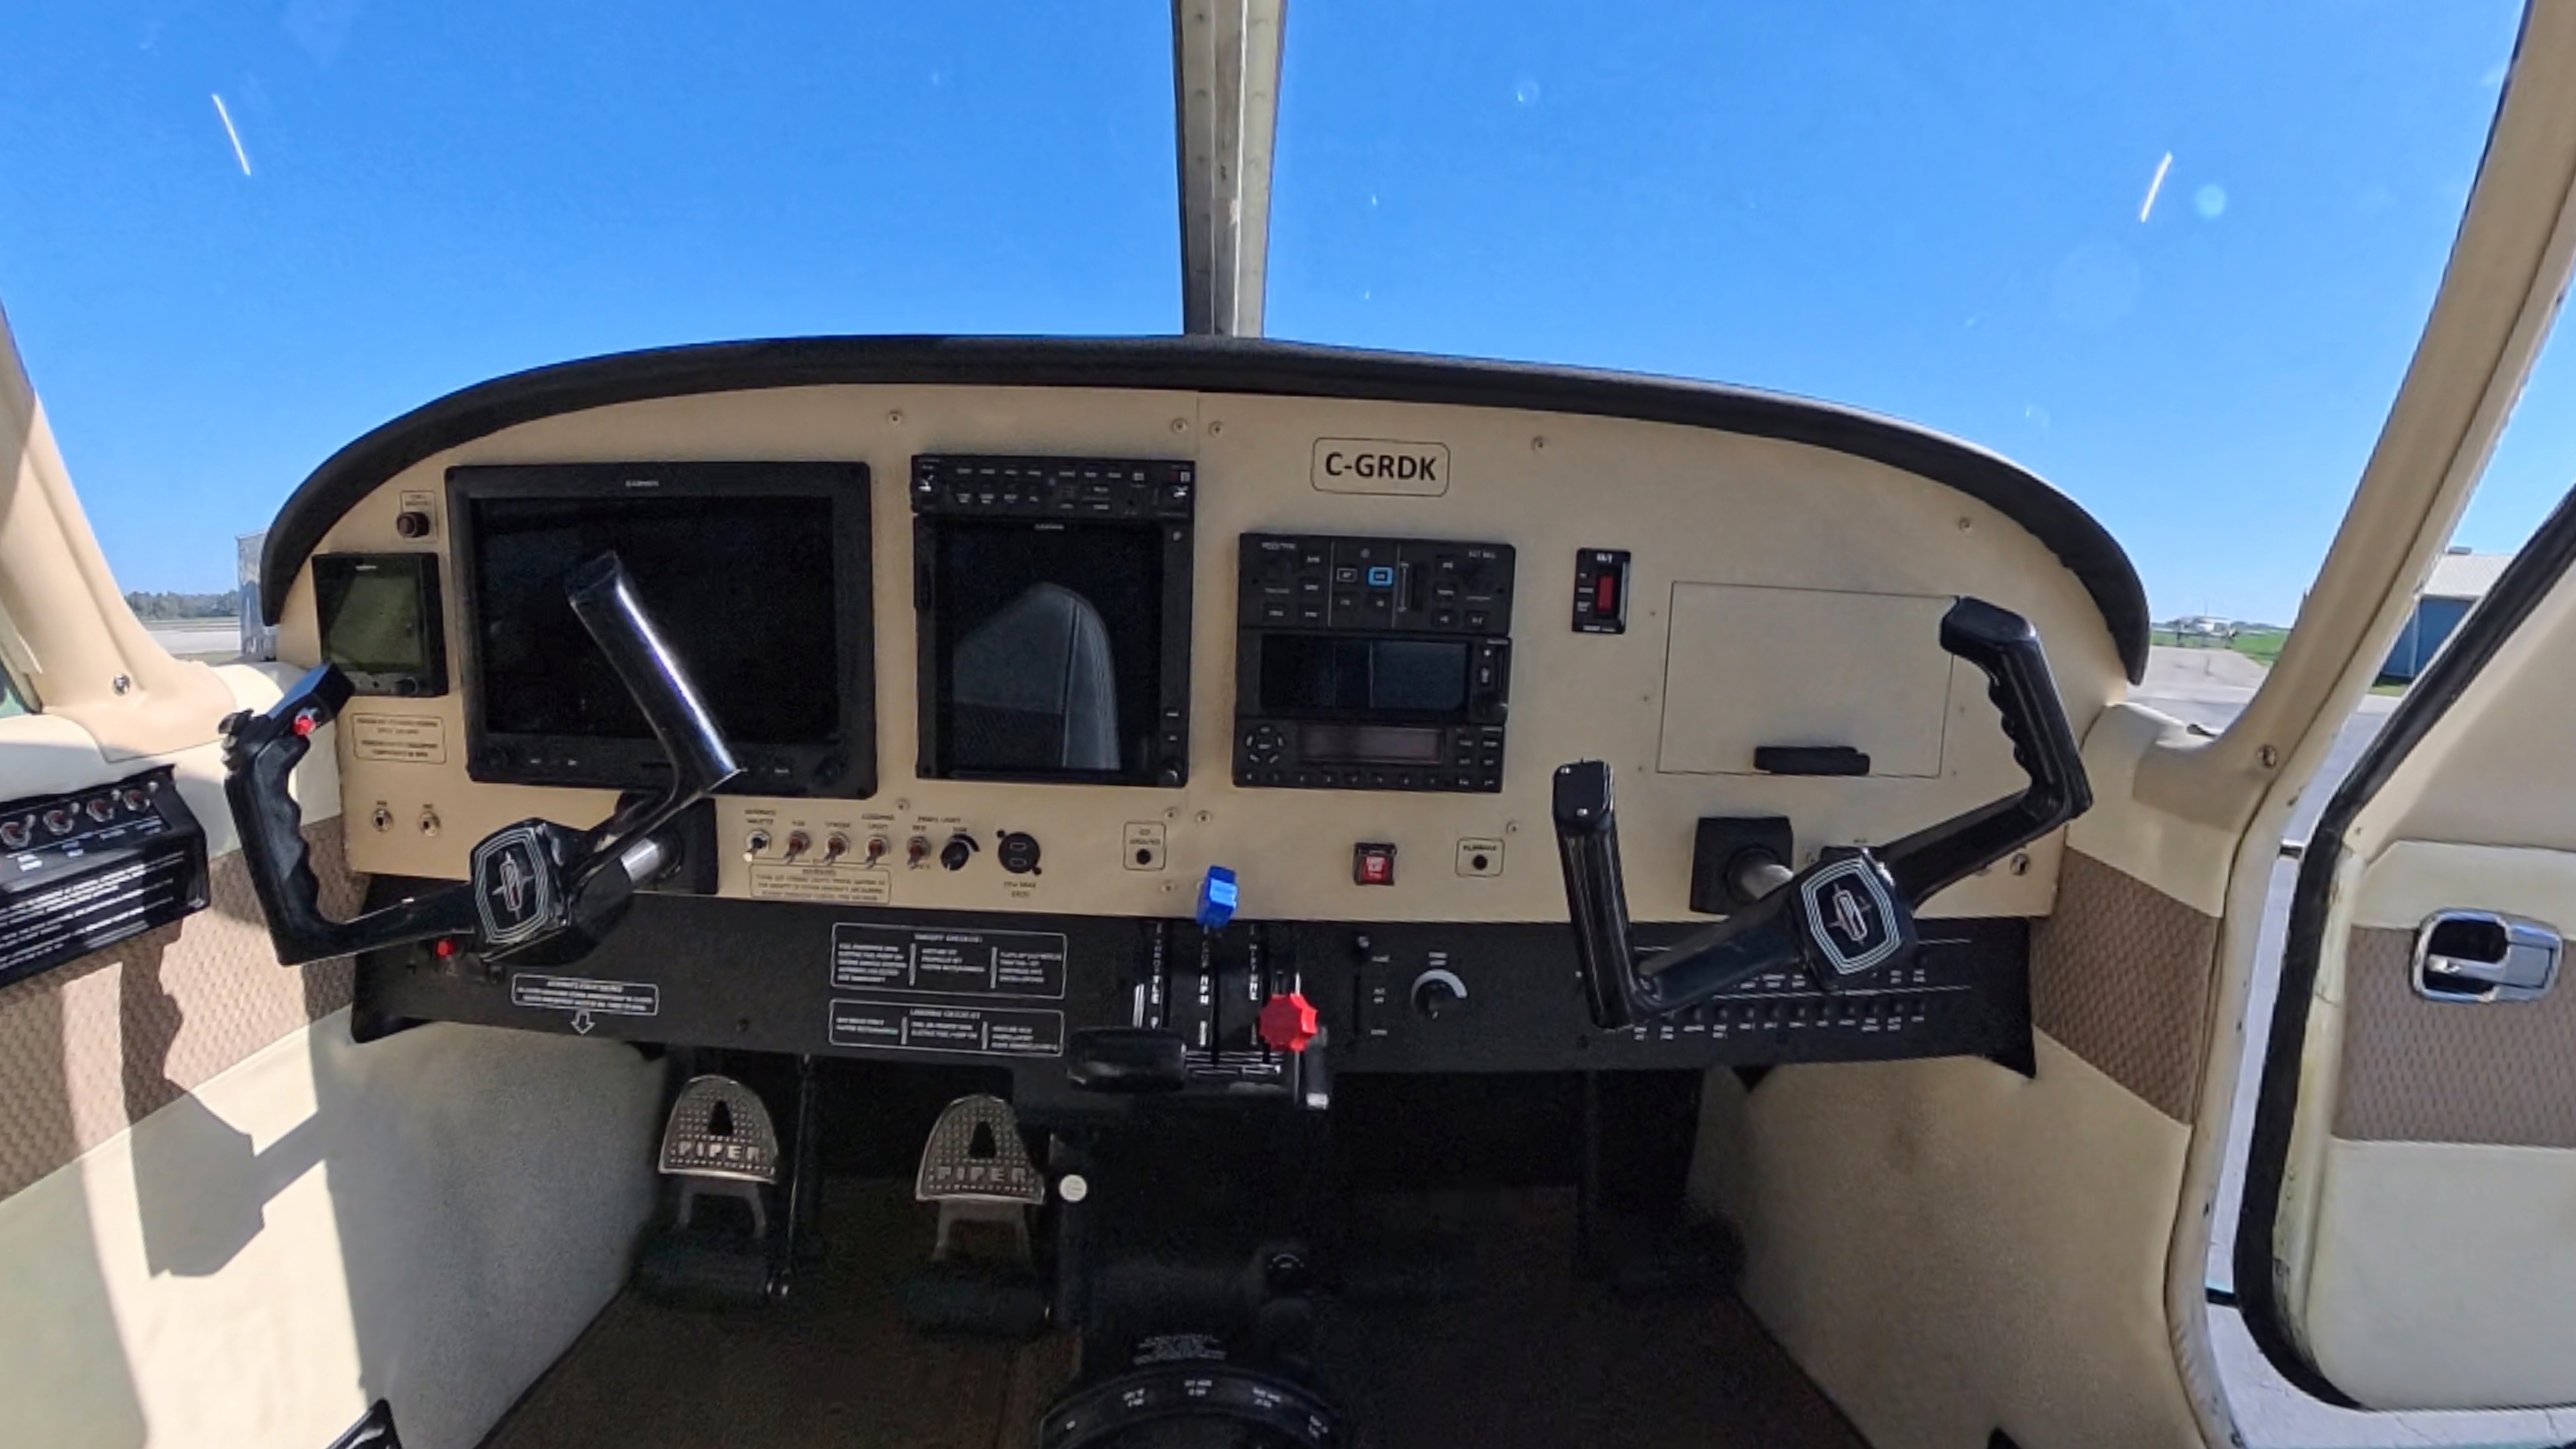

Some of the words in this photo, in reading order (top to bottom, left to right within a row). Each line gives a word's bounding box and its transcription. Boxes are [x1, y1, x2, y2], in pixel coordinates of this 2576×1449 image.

[1326, 451, 1437, 481] C-GRDK
[678, 1140, 761, 1162] PIPER
[937, 1165, 1028, 1184] PIPER
